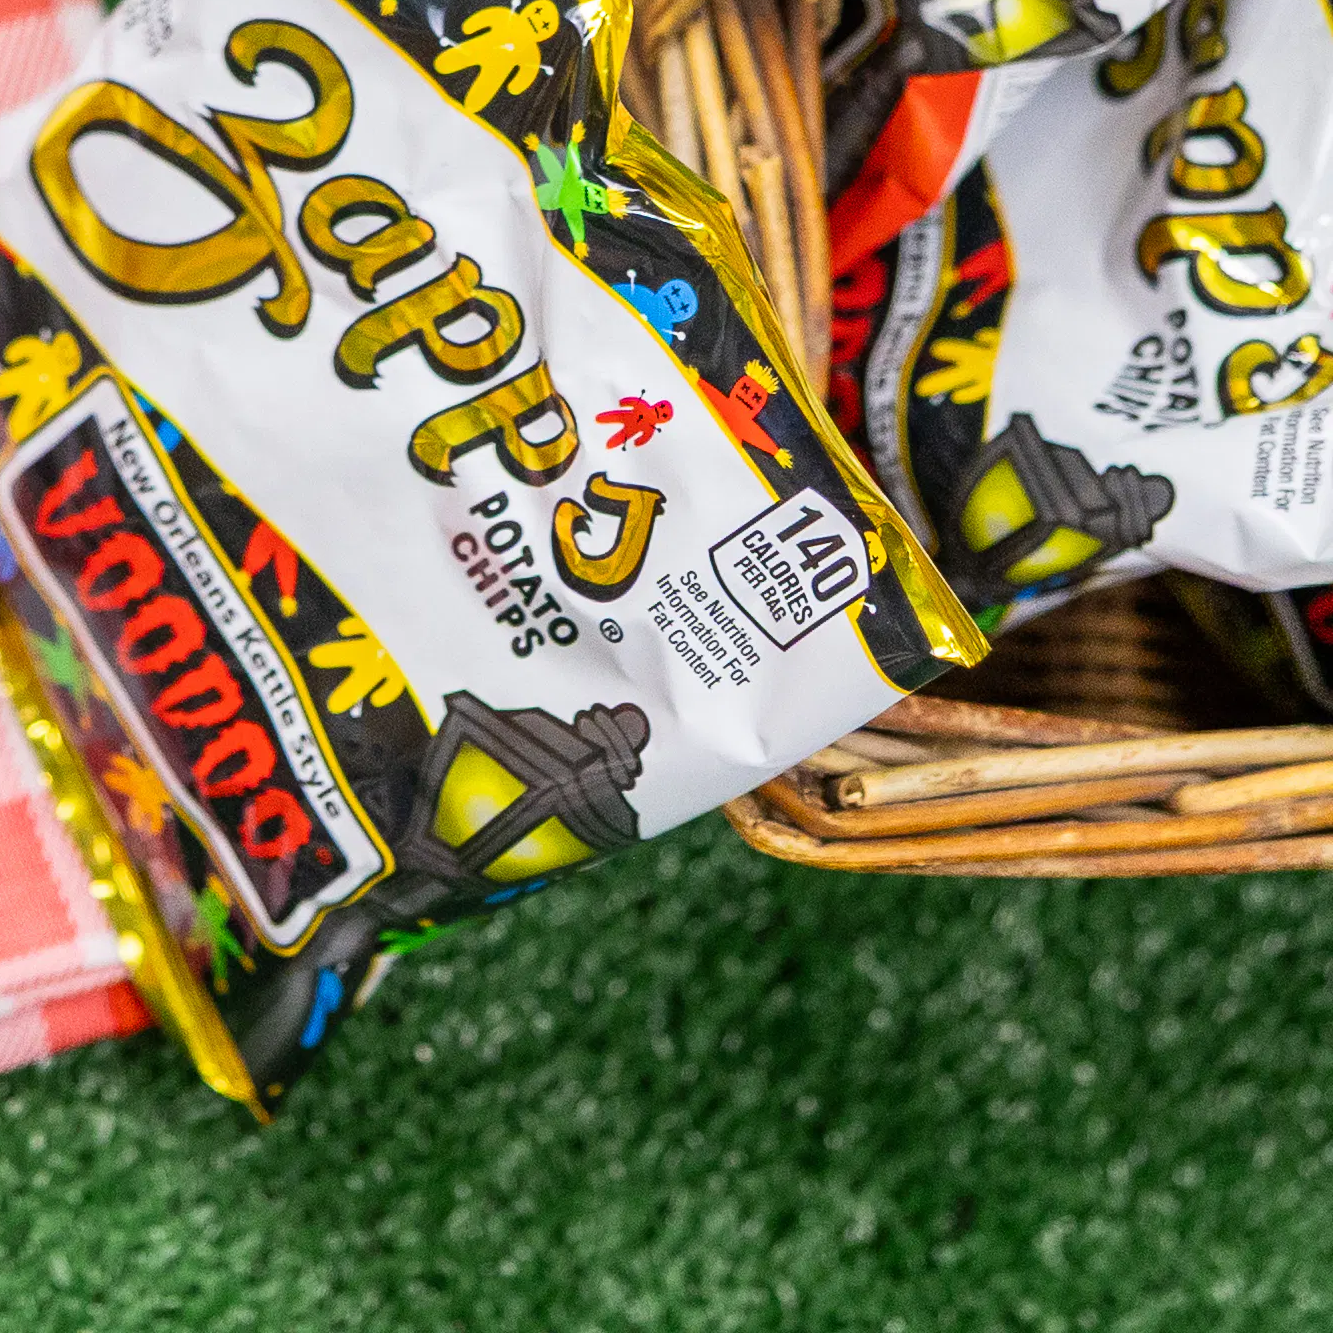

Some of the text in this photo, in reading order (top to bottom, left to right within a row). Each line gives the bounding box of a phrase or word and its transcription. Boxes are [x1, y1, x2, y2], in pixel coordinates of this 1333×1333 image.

[1250, 440, 1277, 499] Content
[1273, 489, 1297, 513] For
[1299, 438, 1326, 505] Nutrition
[449, 530, 547, 660] CHIPS
[469, 489, 582, 648] POTATO
[733, 556, 789, 625] PER BAG
[739, 528, 815, 627] CALORIES
[776, 503, 861, 604] 140
[34, 446, 314, 863] VOODOO
[103, 414, 345, 822] New Orleans Kettle Style
[646, 600, 721, 690] Fat Content
[655, 572, 752, 688] Information For
[678, 569, 763, 669] See Nutrition
